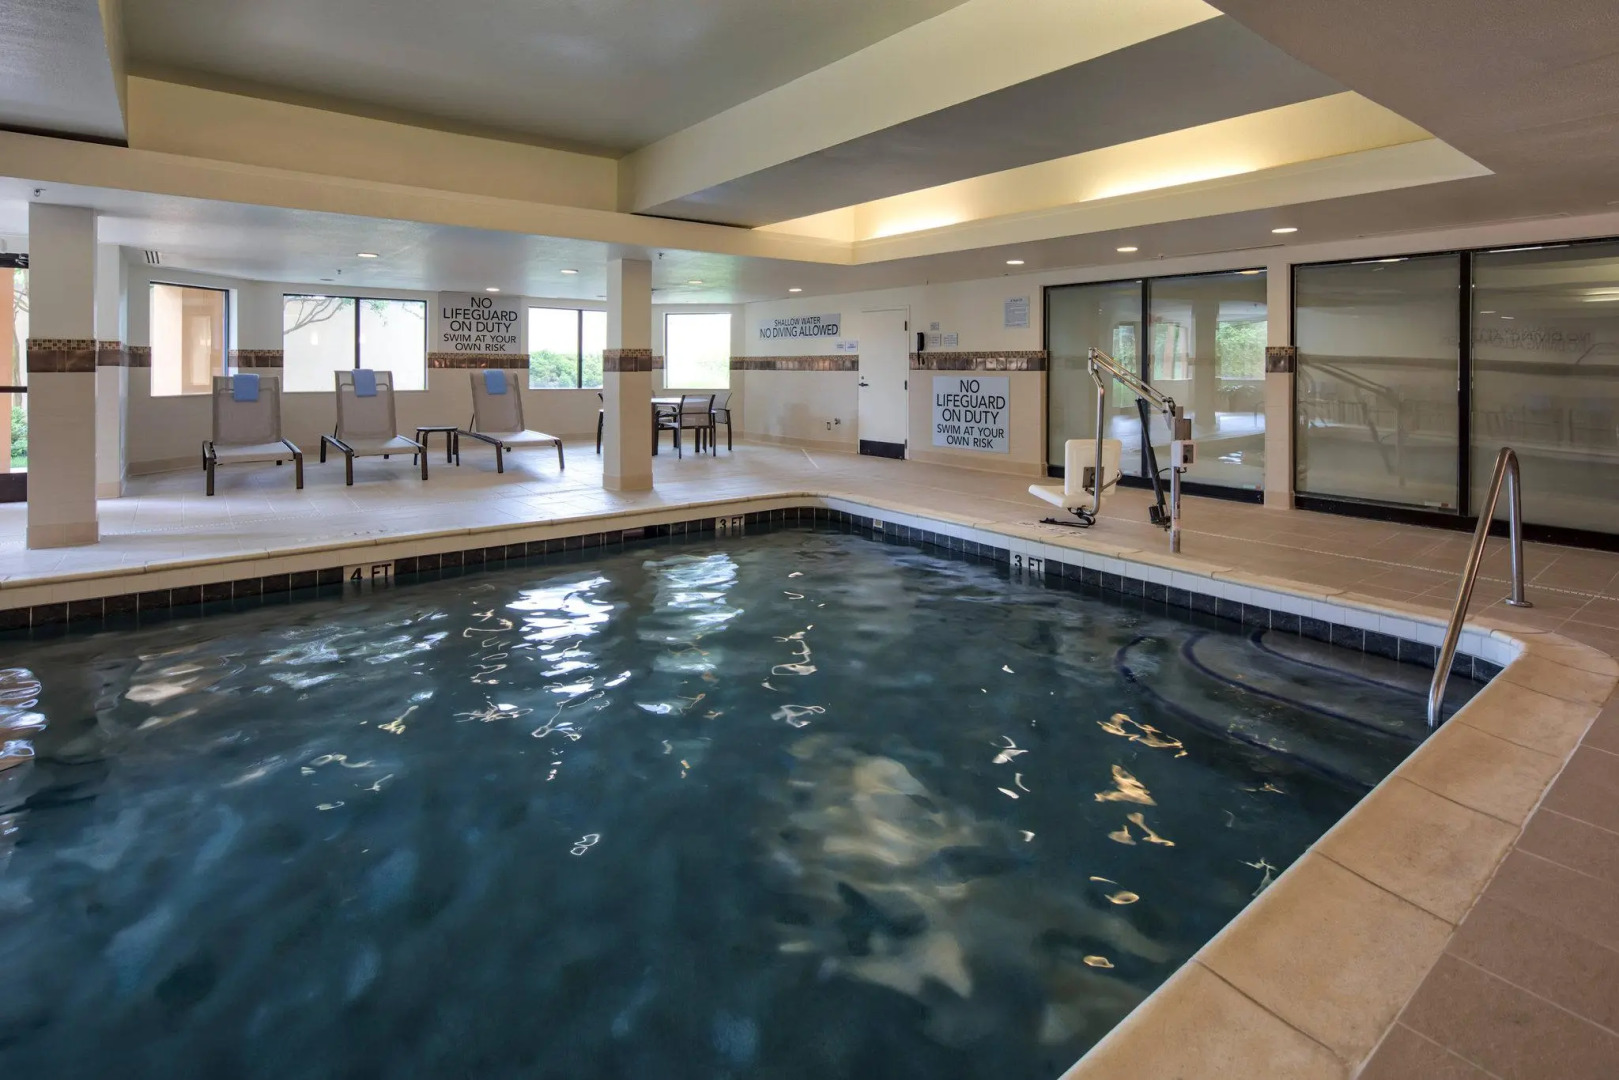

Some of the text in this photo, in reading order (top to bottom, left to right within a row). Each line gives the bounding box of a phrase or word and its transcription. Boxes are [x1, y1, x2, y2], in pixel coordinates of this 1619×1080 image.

[470, 297, 492, 308] NO
[443, 308, 517, 321] LIFEGUARD
[450, 320, 512, 333] ON DUTY
[774, 316, 820, 327] SHALLOW WATER
[760, 324, 838, 338] NO DIVING ALLOWED
[444, 333, 471, 342] SWIM
[490, 335, 516, 343] YOUR
[960, 380, 980, 393] NO
[936, 394, 1006, 409] LIFEGUARD
[942, 408, 999, 424] ON DUTY
[937, 424, 1004, 438] SWIM AT YOUR
[946, 435, 993, 448] OWN RISK
[720, 516, 743, 528] 3 FT
[1015, 554, 1042, 571] 3 FT
[351, 564, 392, 580] 4 FT
